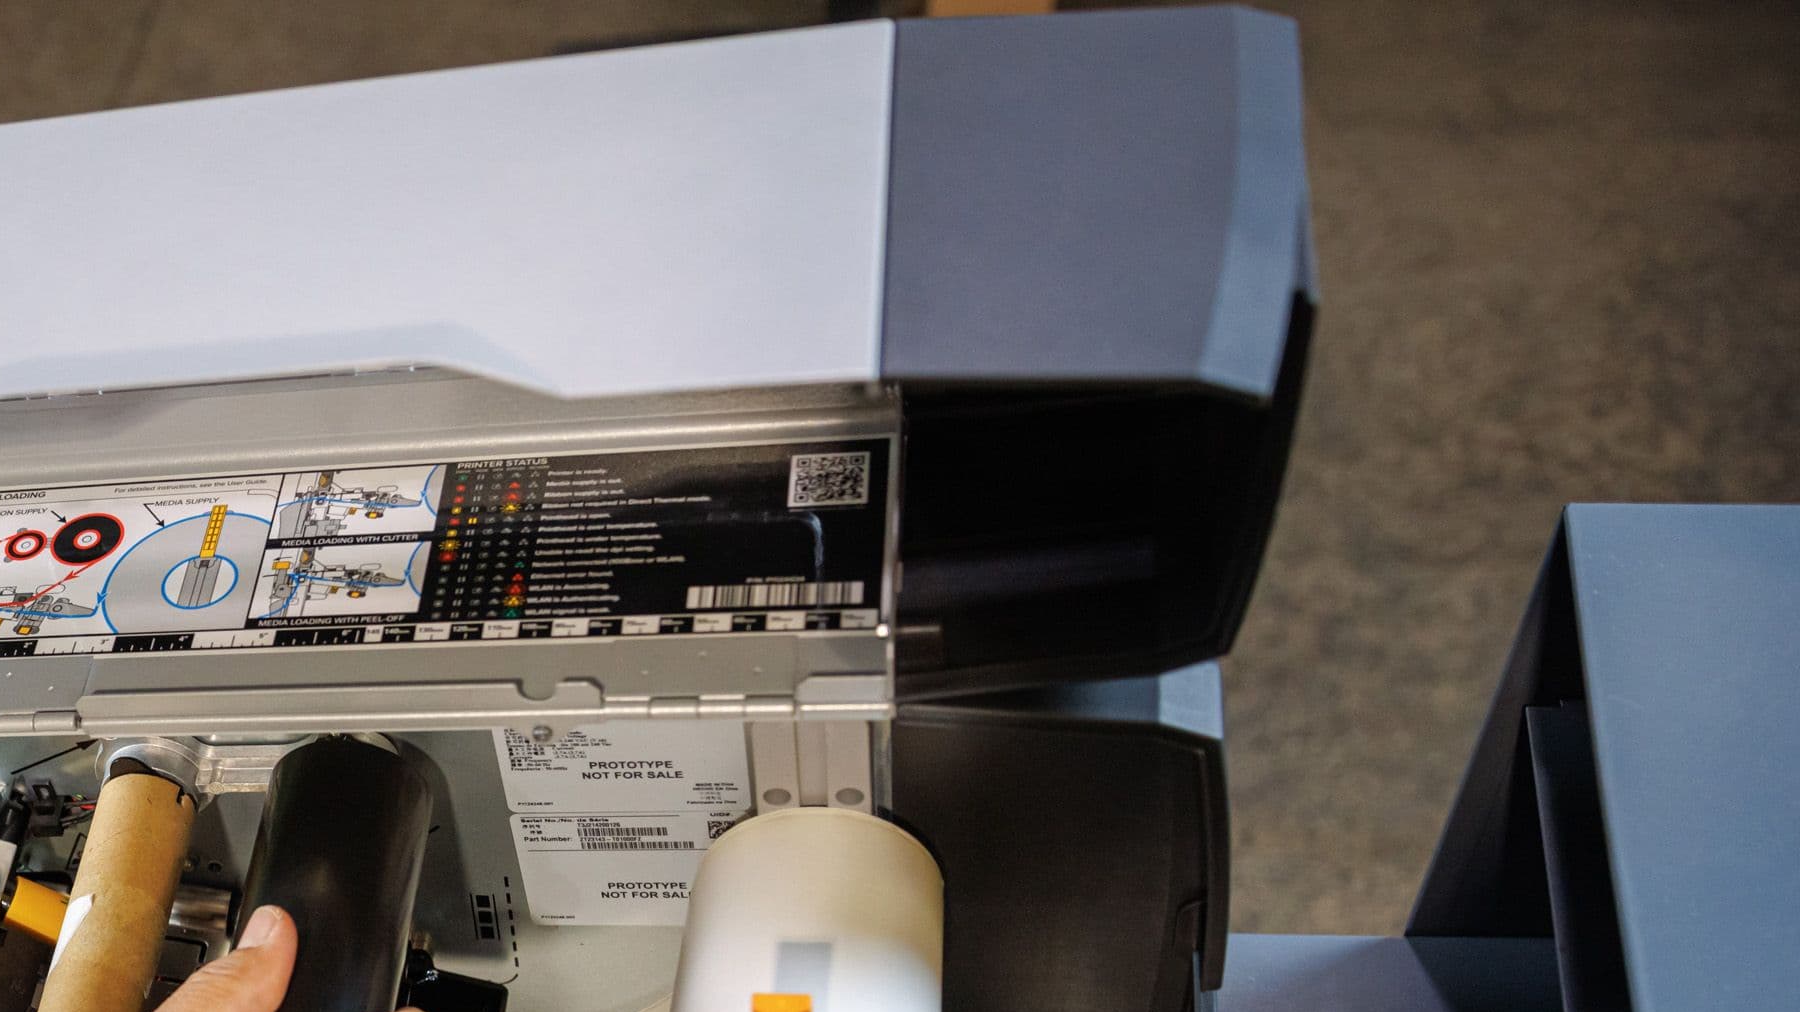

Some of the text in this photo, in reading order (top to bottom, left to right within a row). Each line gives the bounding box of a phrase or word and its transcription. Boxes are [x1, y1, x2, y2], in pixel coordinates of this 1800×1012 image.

[457, 460, 503, 469] PRINTER
[505, 458, 548, 467] STATUS
[0, 491, 46, 501] LOADING
[154, 497, 220, 507] MEDIA SUPPLY
[15, 507, 48, 516] SUPPLY
[281, 534, 418, 547] MEDIA LOADING WITH CUTTER
[258, 614, 406, 627] MEDIA LOADING WITH PEEL-OFF
[589, 760, 673, 769] PROTOTYPE
[614, 771, 643, 779] FOR
[647, 770, 684, 779] SALE
[608, 882, 687, 890] PROTOTYPE
[601, 891, 628, 899] NOT
[632, 891, 658, 899] FOR
